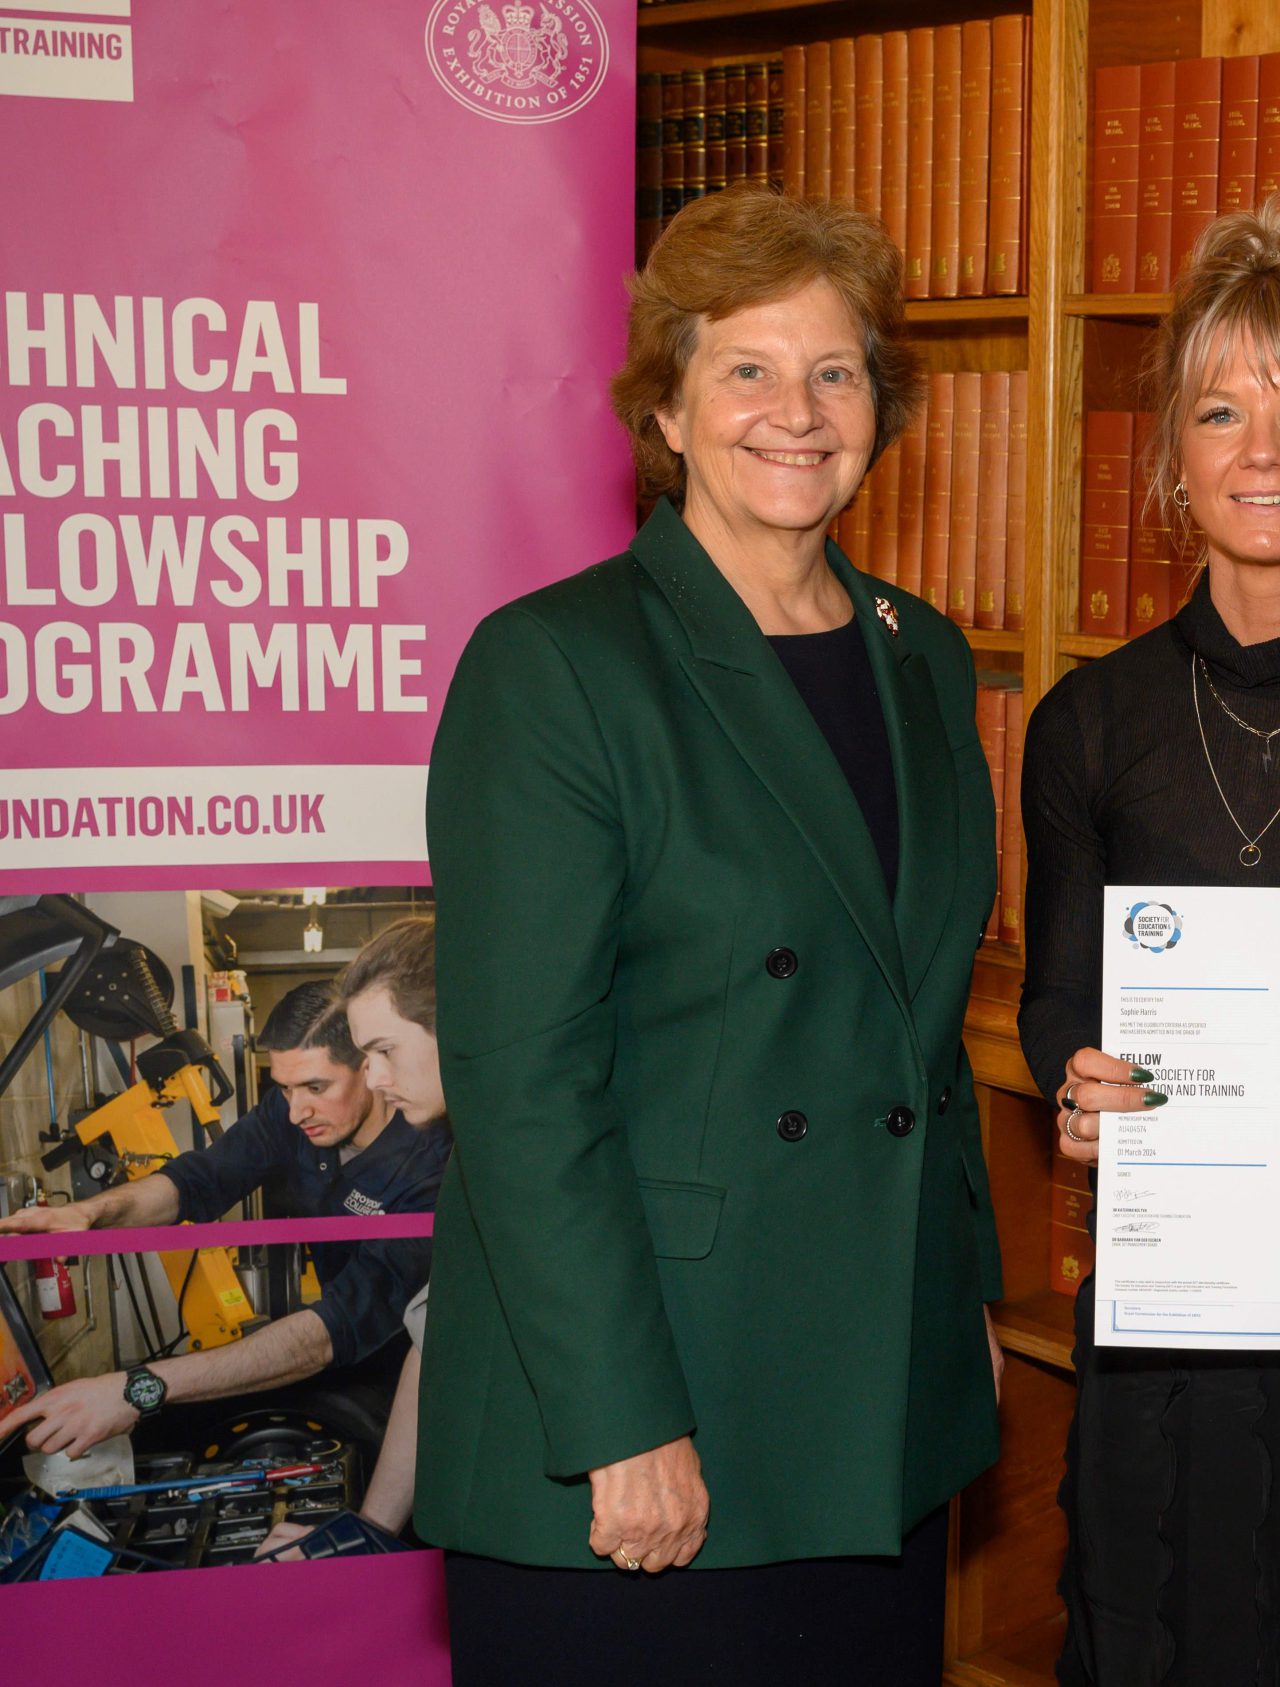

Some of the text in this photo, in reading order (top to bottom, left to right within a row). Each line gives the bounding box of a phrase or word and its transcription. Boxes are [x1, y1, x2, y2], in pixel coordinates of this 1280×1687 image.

[0, 28, 122, 60] TRAINING
[443, 47, 593, 109] EXHIBITION OF 1851
[2, 291, 347, 395] HNICAL
[0, 403, 299, 501] CHING
[2, 513, 409, 607] LOWSHIP
[1120, 1008, 1157, 1016] Sophie Harris
[1120, 1053, 1162, 1065] FELLOW
[1154, 1069, 1215, 1081] SOCIETY FOR
[1176, 1084, 1245, 1097] AND TRAINING
